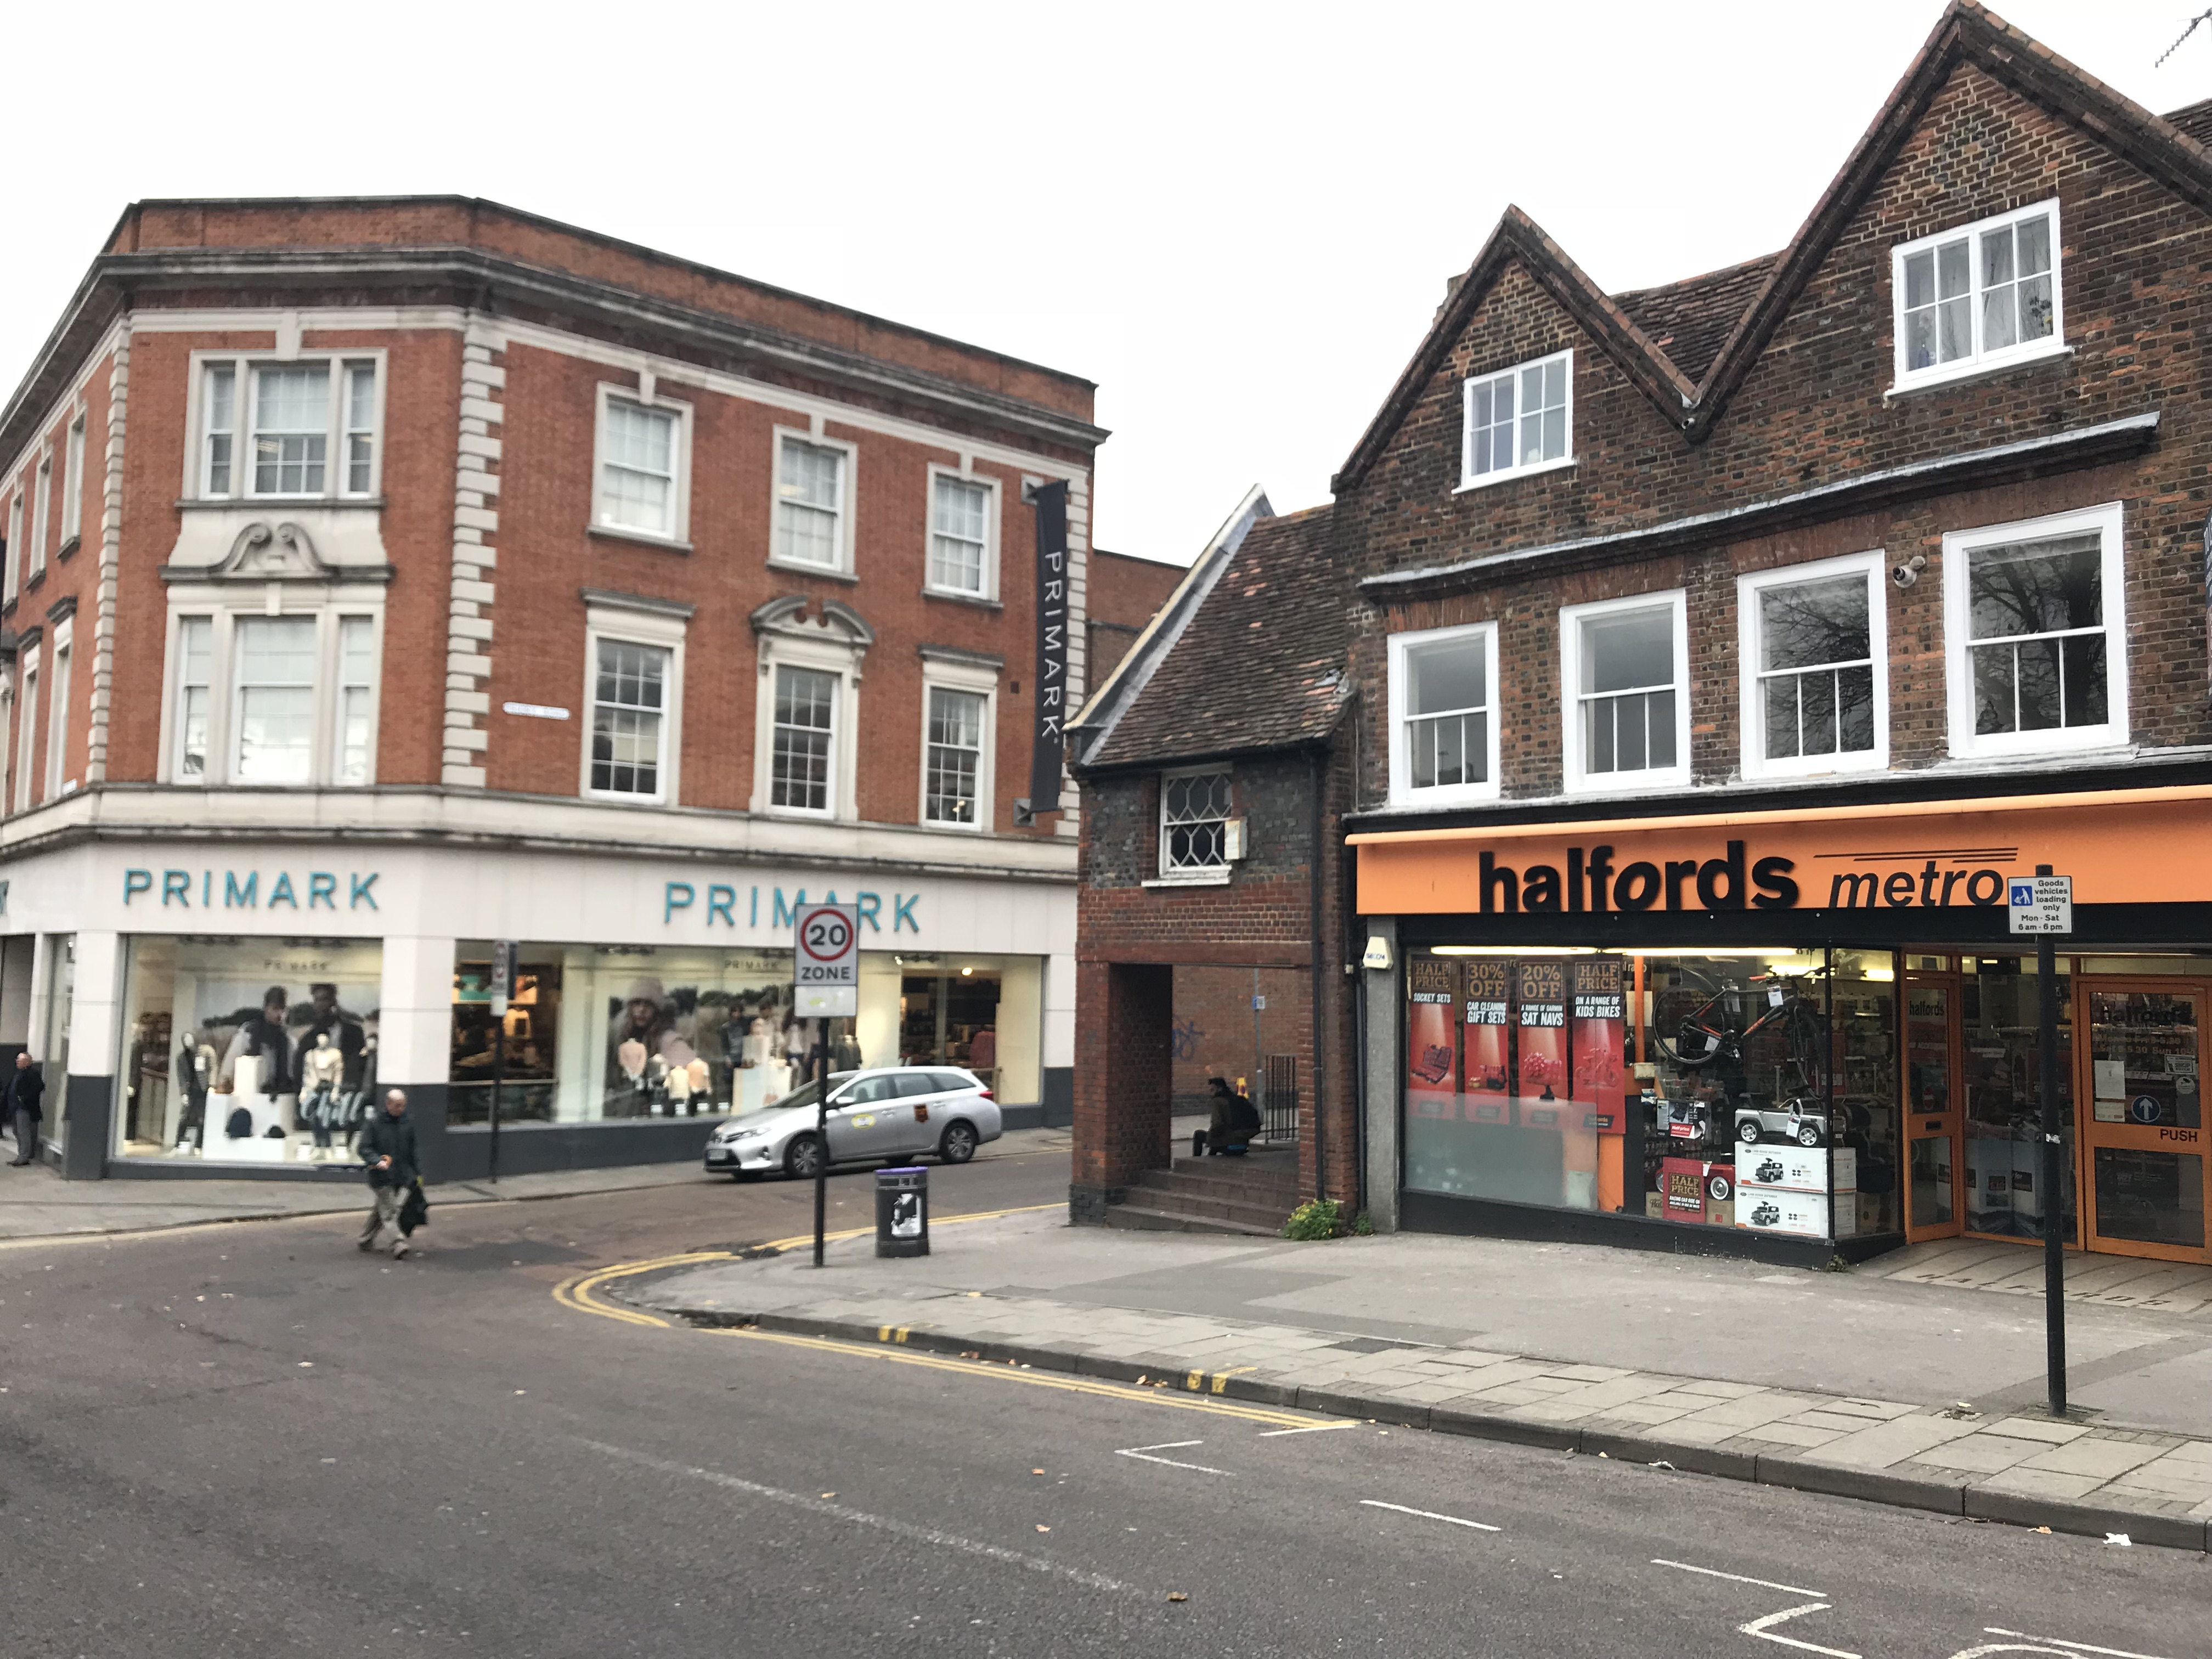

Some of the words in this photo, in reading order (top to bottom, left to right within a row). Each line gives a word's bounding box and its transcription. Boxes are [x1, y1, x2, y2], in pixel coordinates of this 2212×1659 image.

[1042, 551, 1064, 738] PRIMARK
[1479, 840, 1799, 912] halfords
[1829, 861, 2004, 908] metro
[123, 868, 379, 910] PRIMARK
[809, 924, 847, 946] 20
[802, 966, 850, 980] ZONE
[1415, 963, 1449, 975] HALF
[1469, 964, 1505, 979] 30%
[1522, 964, 1561, 980] 20%
[1580, 964, 1617, 977] HALF
[1415, 975, 1449, 988] PRICE
[1469, 980, 1505, 996] OFF
[1578, 977, 1617, 990] PRICE
[1523, 981, 1560, 998] OFF
[1413, 992, 1435, 1003] SOCKET
[1437, 993, 1451, 1003] SETS
[1575, 996, 1583, 1005] ON
[1585, 997, 1589, 1005] A
[1591, 996, 1610, 1005] RANGE
[1611, 996, 1620, 1005] OF
[1467, 1001, 1479, 1011] CAR
[1480, 1002, 1506, 1012] CLEANING
[1575, 1006, 1594, 1017] KIDS
[1596, 1006, 1621, 1018] BIKES
[1909, 1000, 1945, 1015] halfords
[1467, 1011, 1486, 1024] GIFT
[1487, 1012, 1506, 1024] SETS
[1521, 1012, 1537, 1026] SAT
[1540, 1012, 1563, 1026] NAVS
[2159, 1128, 2198, 1142] PUSH
[1671, 1175, 1699, 1188] HALF
[1671, 1185, 1699, 1196] PRICE
